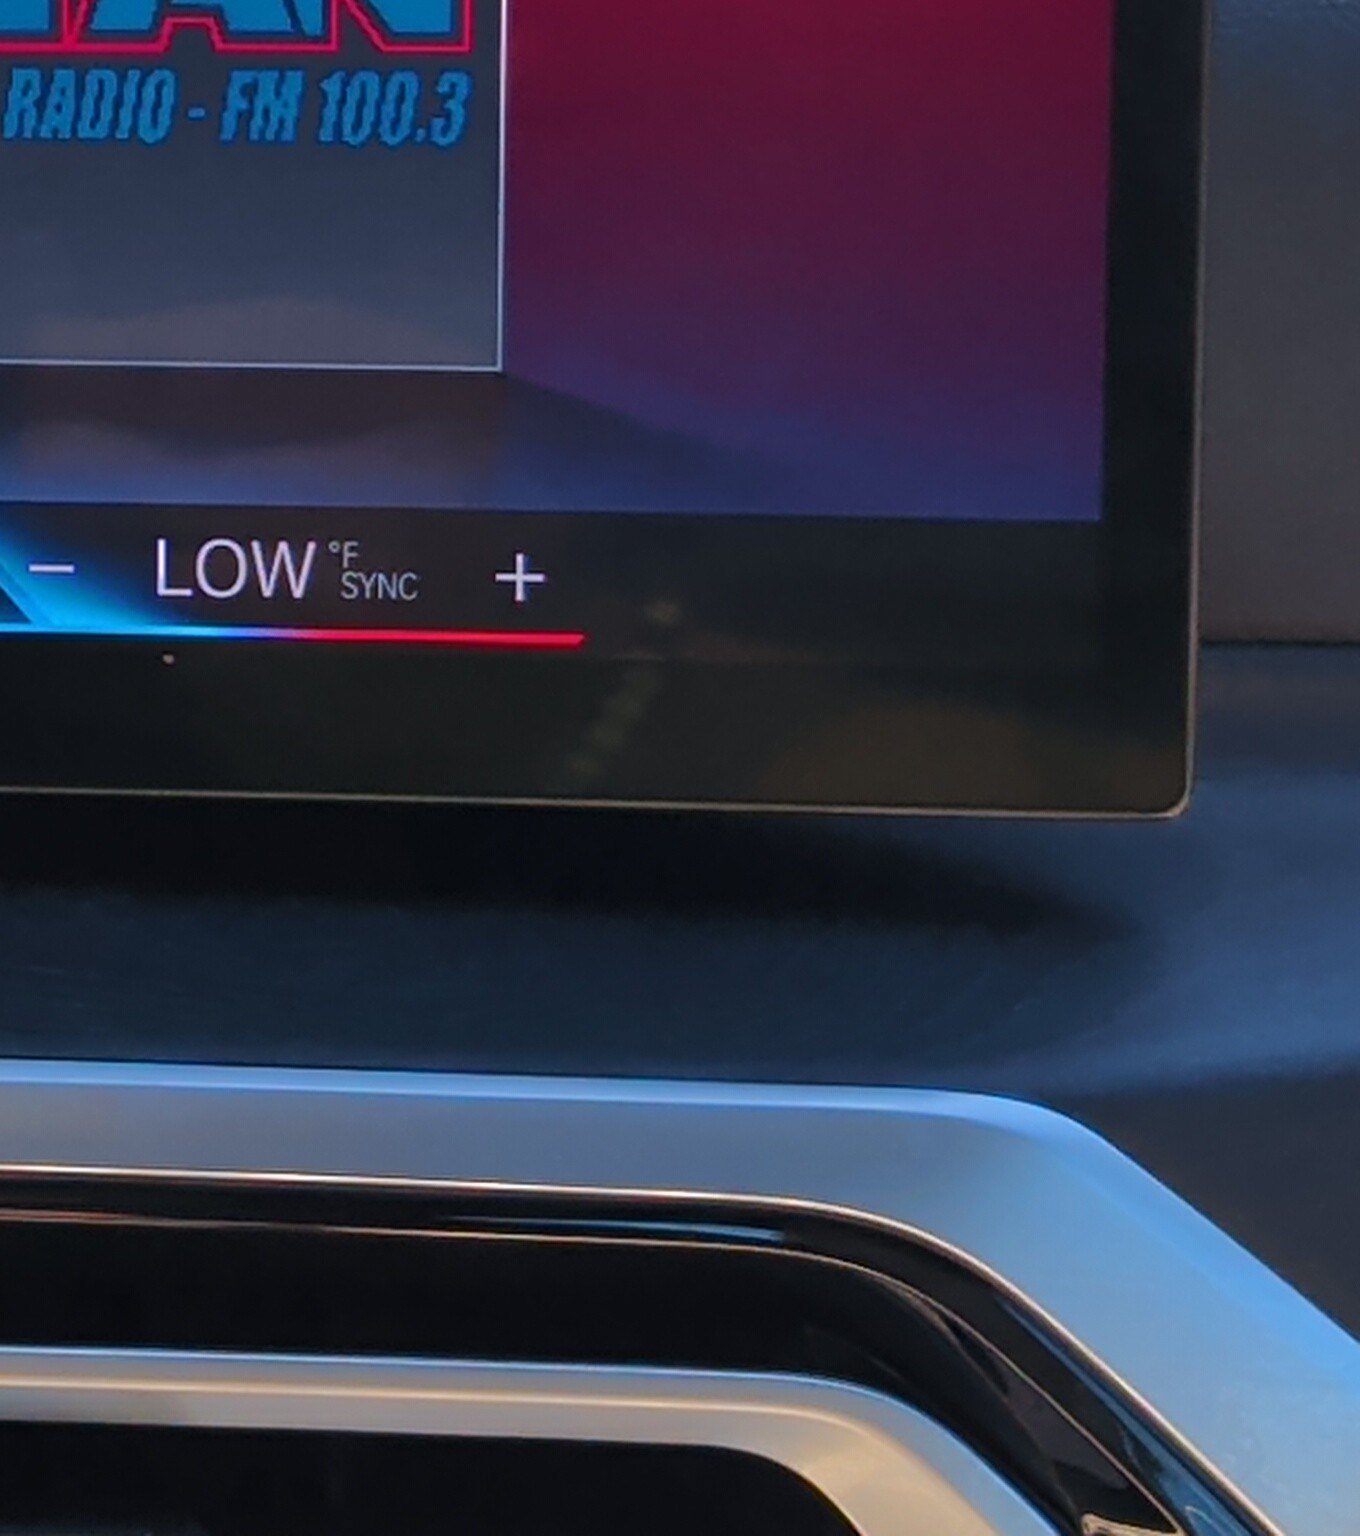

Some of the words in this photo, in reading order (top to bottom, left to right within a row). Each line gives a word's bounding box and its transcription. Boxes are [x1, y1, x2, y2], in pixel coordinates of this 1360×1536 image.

[2, 67, 176, 144] RADIO
[219, 69, 306, 144] FM
[317, 69, 472, 147] 100.3
[155, 537, 317, 600] LOW
[340, 572, 419, 601] SYNC
